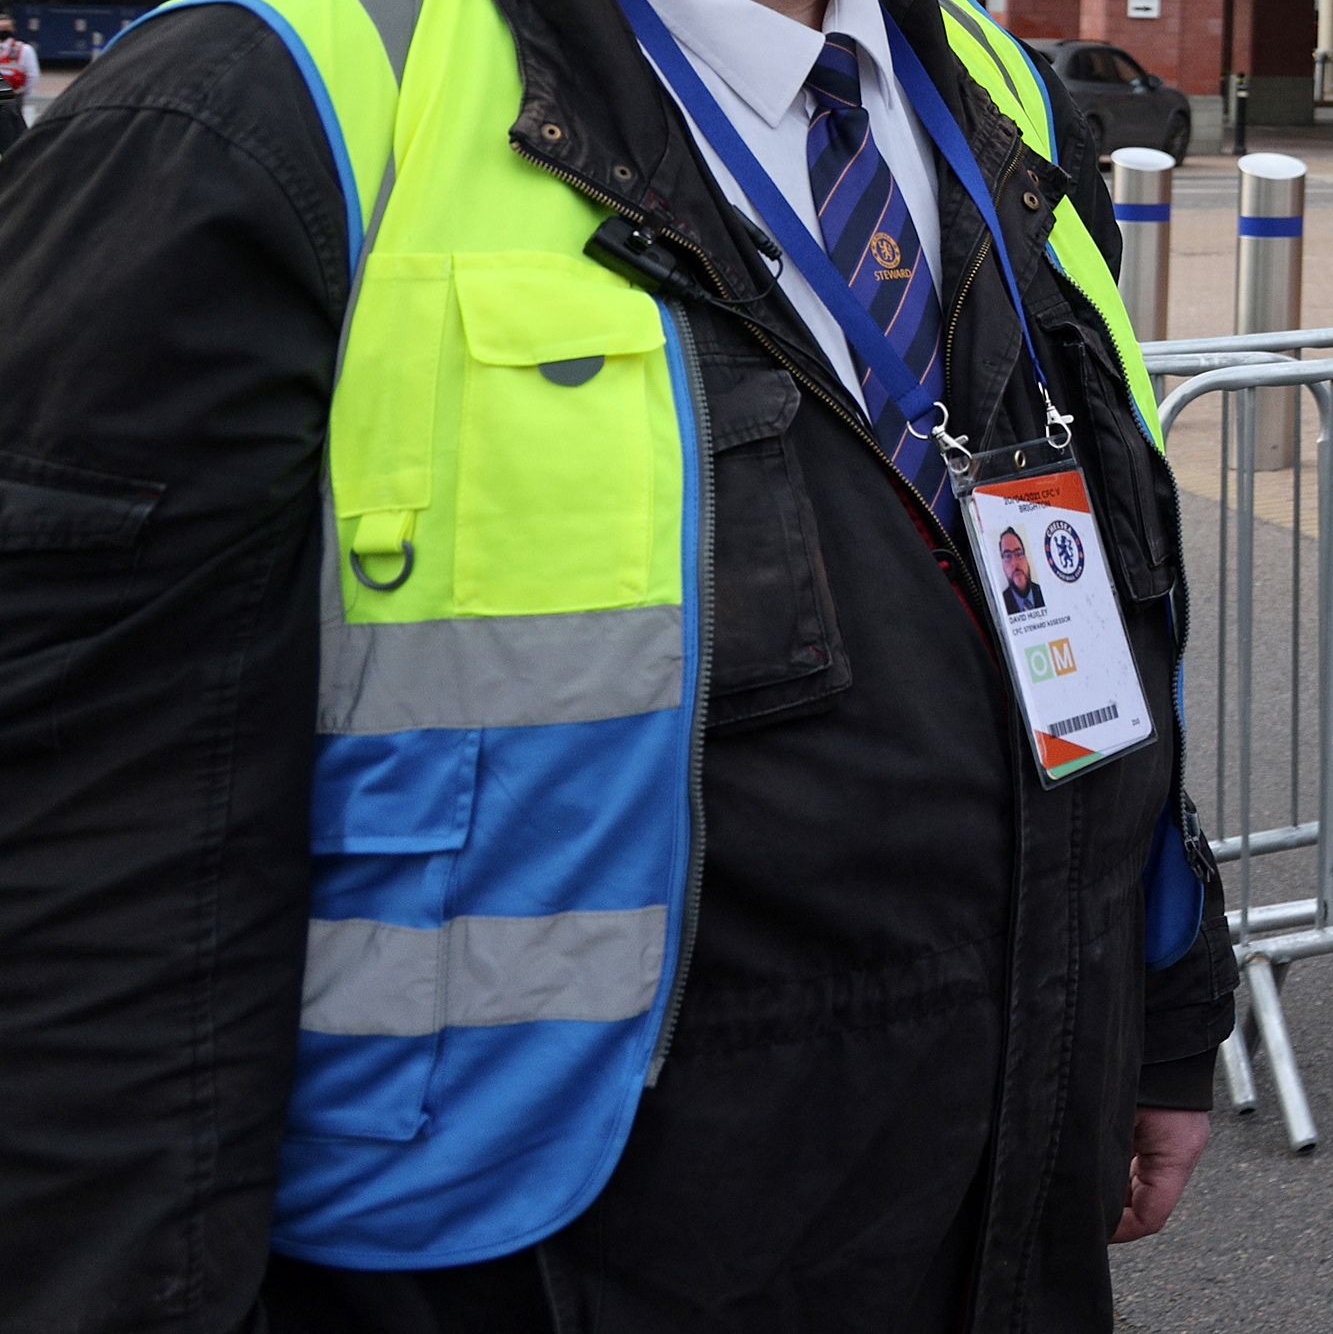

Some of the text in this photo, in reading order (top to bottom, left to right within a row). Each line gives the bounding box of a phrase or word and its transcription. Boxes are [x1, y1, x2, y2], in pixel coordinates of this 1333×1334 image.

[873, 268, 912, 282] STEWARD
[1018, 499, 1052, 513] BRIGHTON
[1046, 521, 1073, 538] CHELSEA
[1009, 613, 1027, 625] DAVID
[1051, 642, 1074, 671] M
